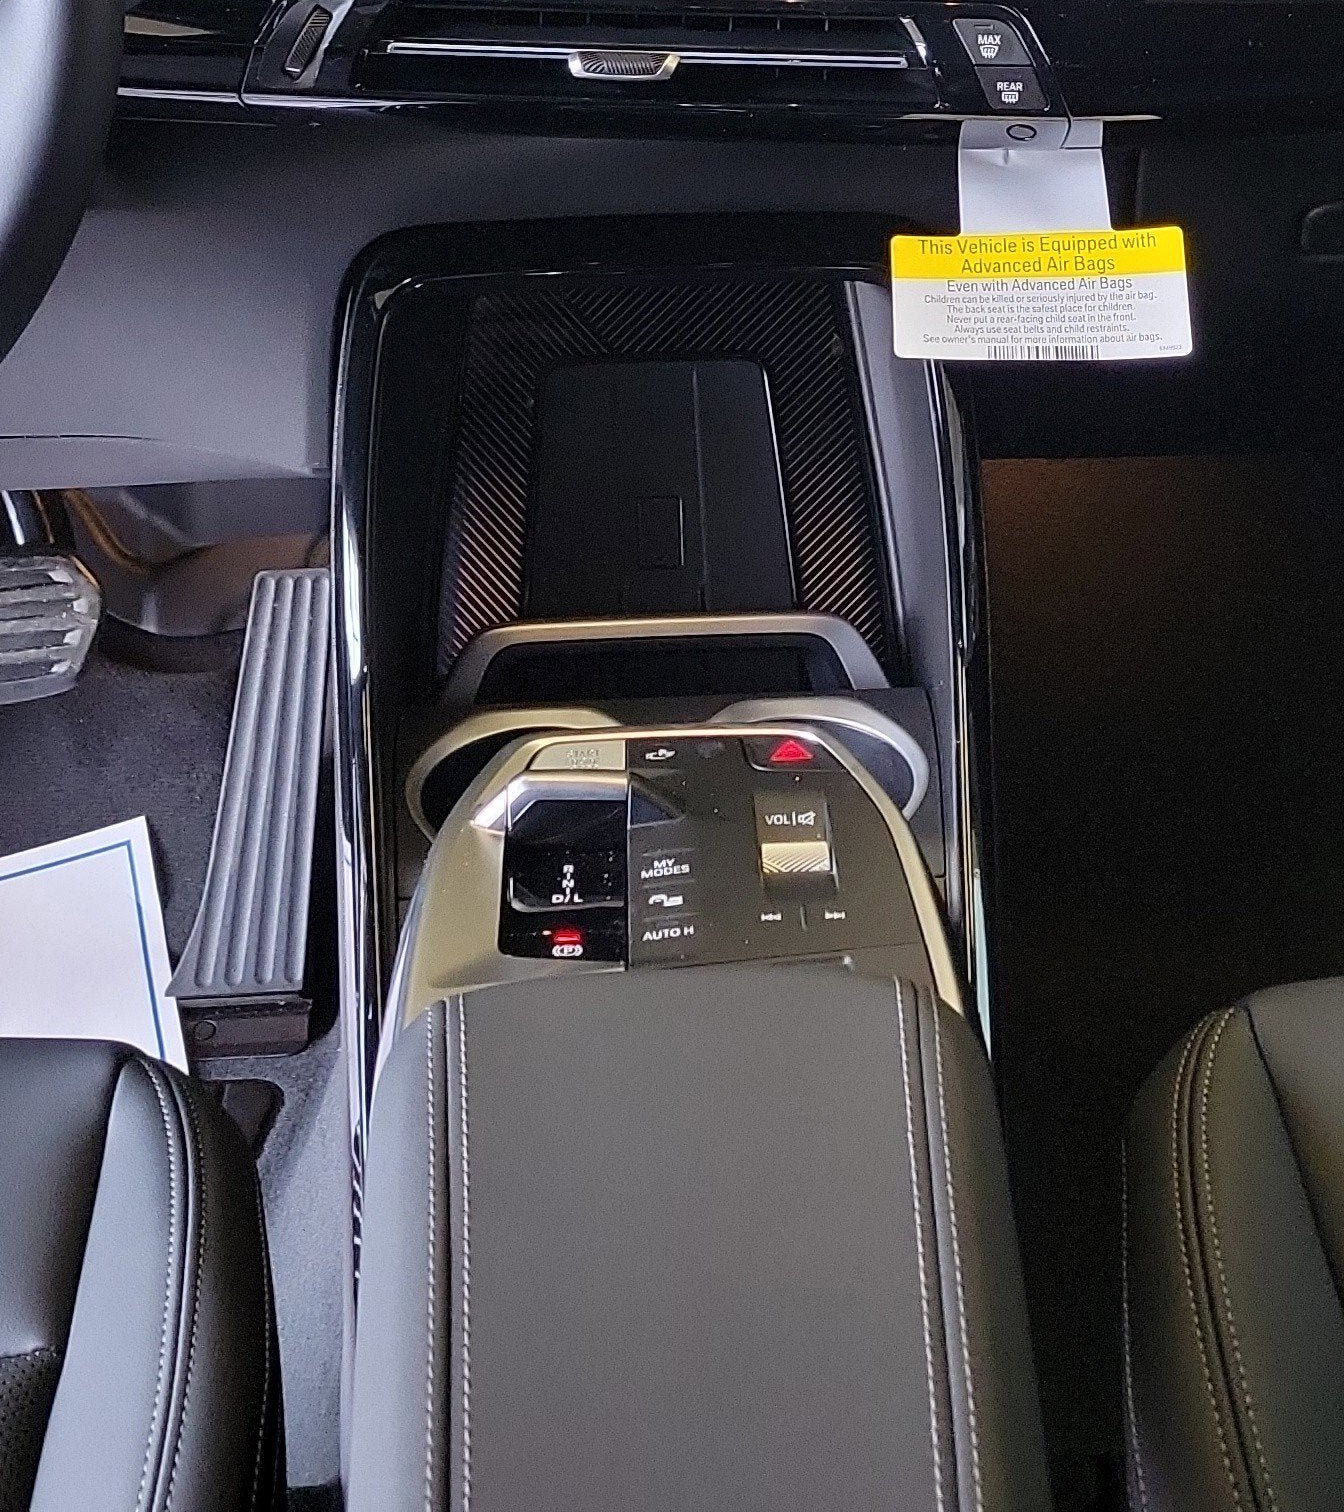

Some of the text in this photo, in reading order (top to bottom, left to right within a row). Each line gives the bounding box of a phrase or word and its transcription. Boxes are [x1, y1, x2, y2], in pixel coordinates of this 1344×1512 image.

[977, 34, 1002, 45] MAX
[996, 81, 1023, 92] REAR
[919, 232, 1157, 255] This Vehicle is Equipped with
[961, 255, 1116, 274] Advanced Air Bags
[947, 276, 1133, 292] Even with Advanced Air Bags
[924, 294, 960, 304] Children
[979, 295, 990, 303] be
[991, 294, 1014, 303] killed
[1026, 293, 1064, 304] seriously
[1066, 293, 1096, 304] injured
[1097, 293, 1108, 303] by
[1109, 292, 1123, 301] the
[1125, 291, 1136, 301] air
[1137, 290, 1158, 301] bag.
[947, 302, 1136, 314] The back seat is the safest place for children.
[946, 314, 972, 324] Never
[973, 314, 988, 325] put
[996, 314, 1044, 325] rear-facing
[1045, 314, 1066, 323] child
[1067, 314, 1086, 323] seat
[1087, 313, 1096, 322] in
[1097, 313, 1112, 322] the
[1113, 312, 1137, 322] front.
[954, 323, 1130, 335] Always use seat belts and child restraints.
[923, 332, 1163, 344] See owner's manual for more information about air bags.
[765, 814, 791, 826] VOL
[654, 858, 676, 869] MY
[641, 864, 690, 879] MODES
[562, 879, 574, 888] N
[642, 925, 694, 941] AUTO H
